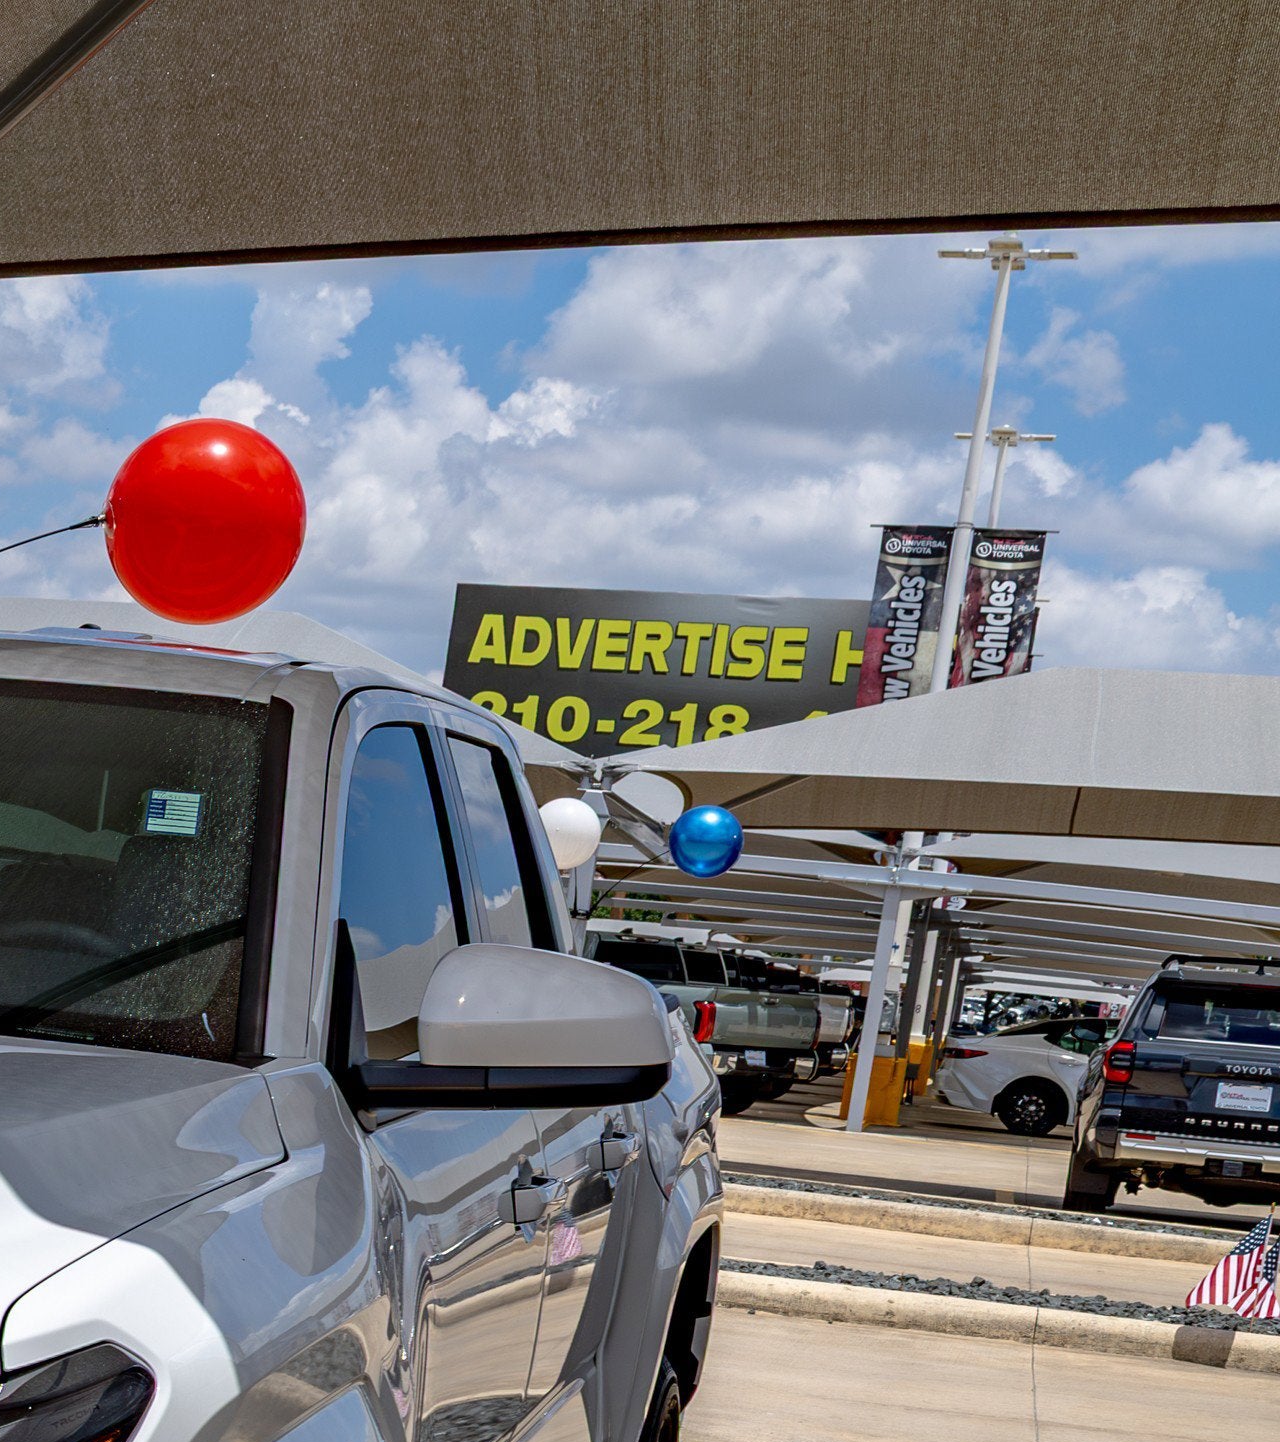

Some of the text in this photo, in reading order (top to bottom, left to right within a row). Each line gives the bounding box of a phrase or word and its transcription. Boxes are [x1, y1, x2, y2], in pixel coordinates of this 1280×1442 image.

[902, 539, 947, 549] UNIVERSAL
[993, 544, 1040, 552] UNIVERSAL
[902, 546, 931, 554] TOYOTA
[992, 550, 1024, 559] TOYOTA
[882, 575, 926, 673] Vehicles
[971, 580, 1017, 679] Vehicles
[467, 613, 809, 681] ADVERTISE
[1225, 1064, 1273, 1076] TOYOTA
